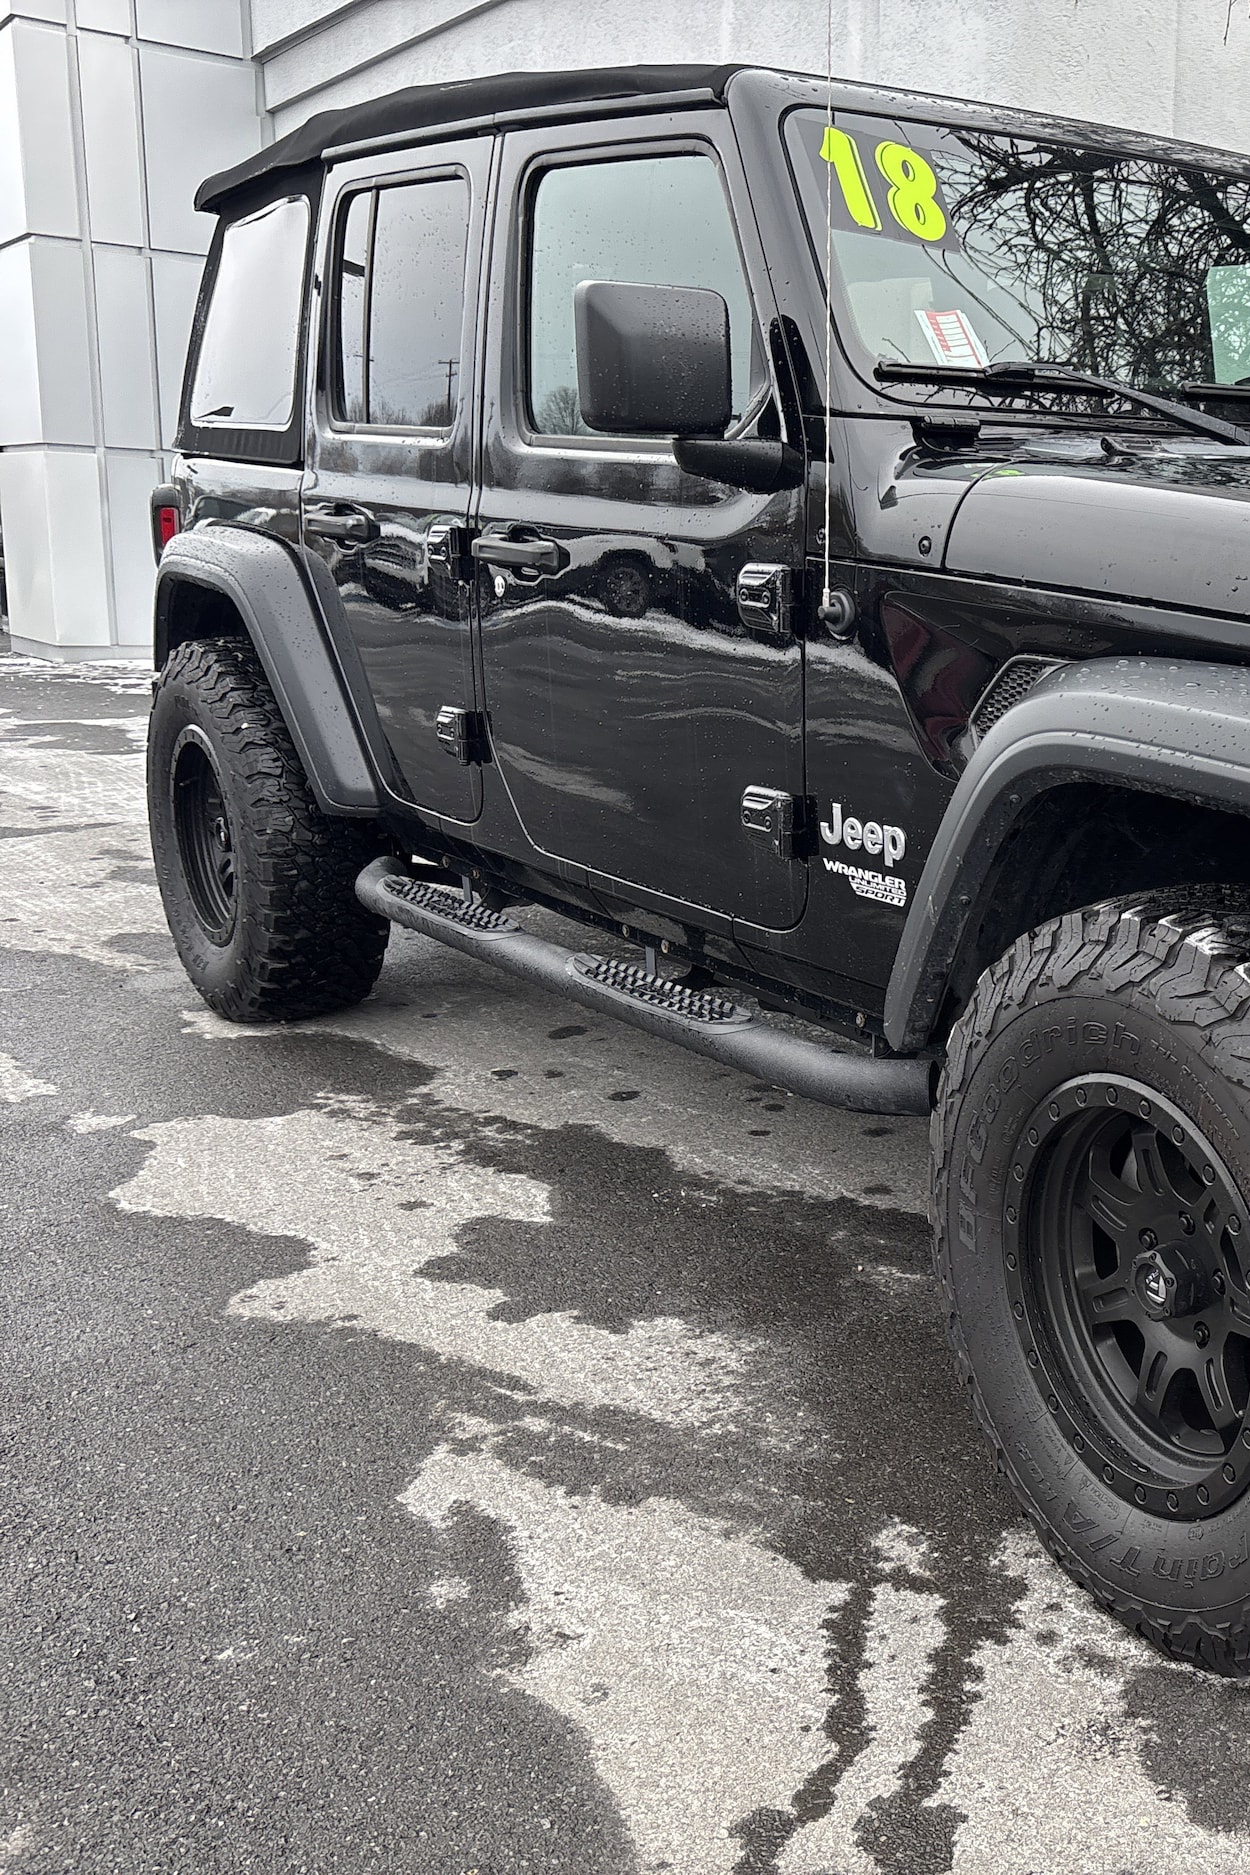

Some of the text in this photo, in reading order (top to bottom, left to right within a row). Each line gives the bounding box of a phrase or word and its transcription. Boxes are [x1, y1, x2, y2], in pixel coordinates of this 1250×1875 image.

[820, 127, 947, 242] 18
[820, 803, 906, 868] Jeep
[823, 857, 907, 891] WRANGLER
[848, 875, 907, 897] UNLIMITED
[854, 885, 905, 905] SPORT
